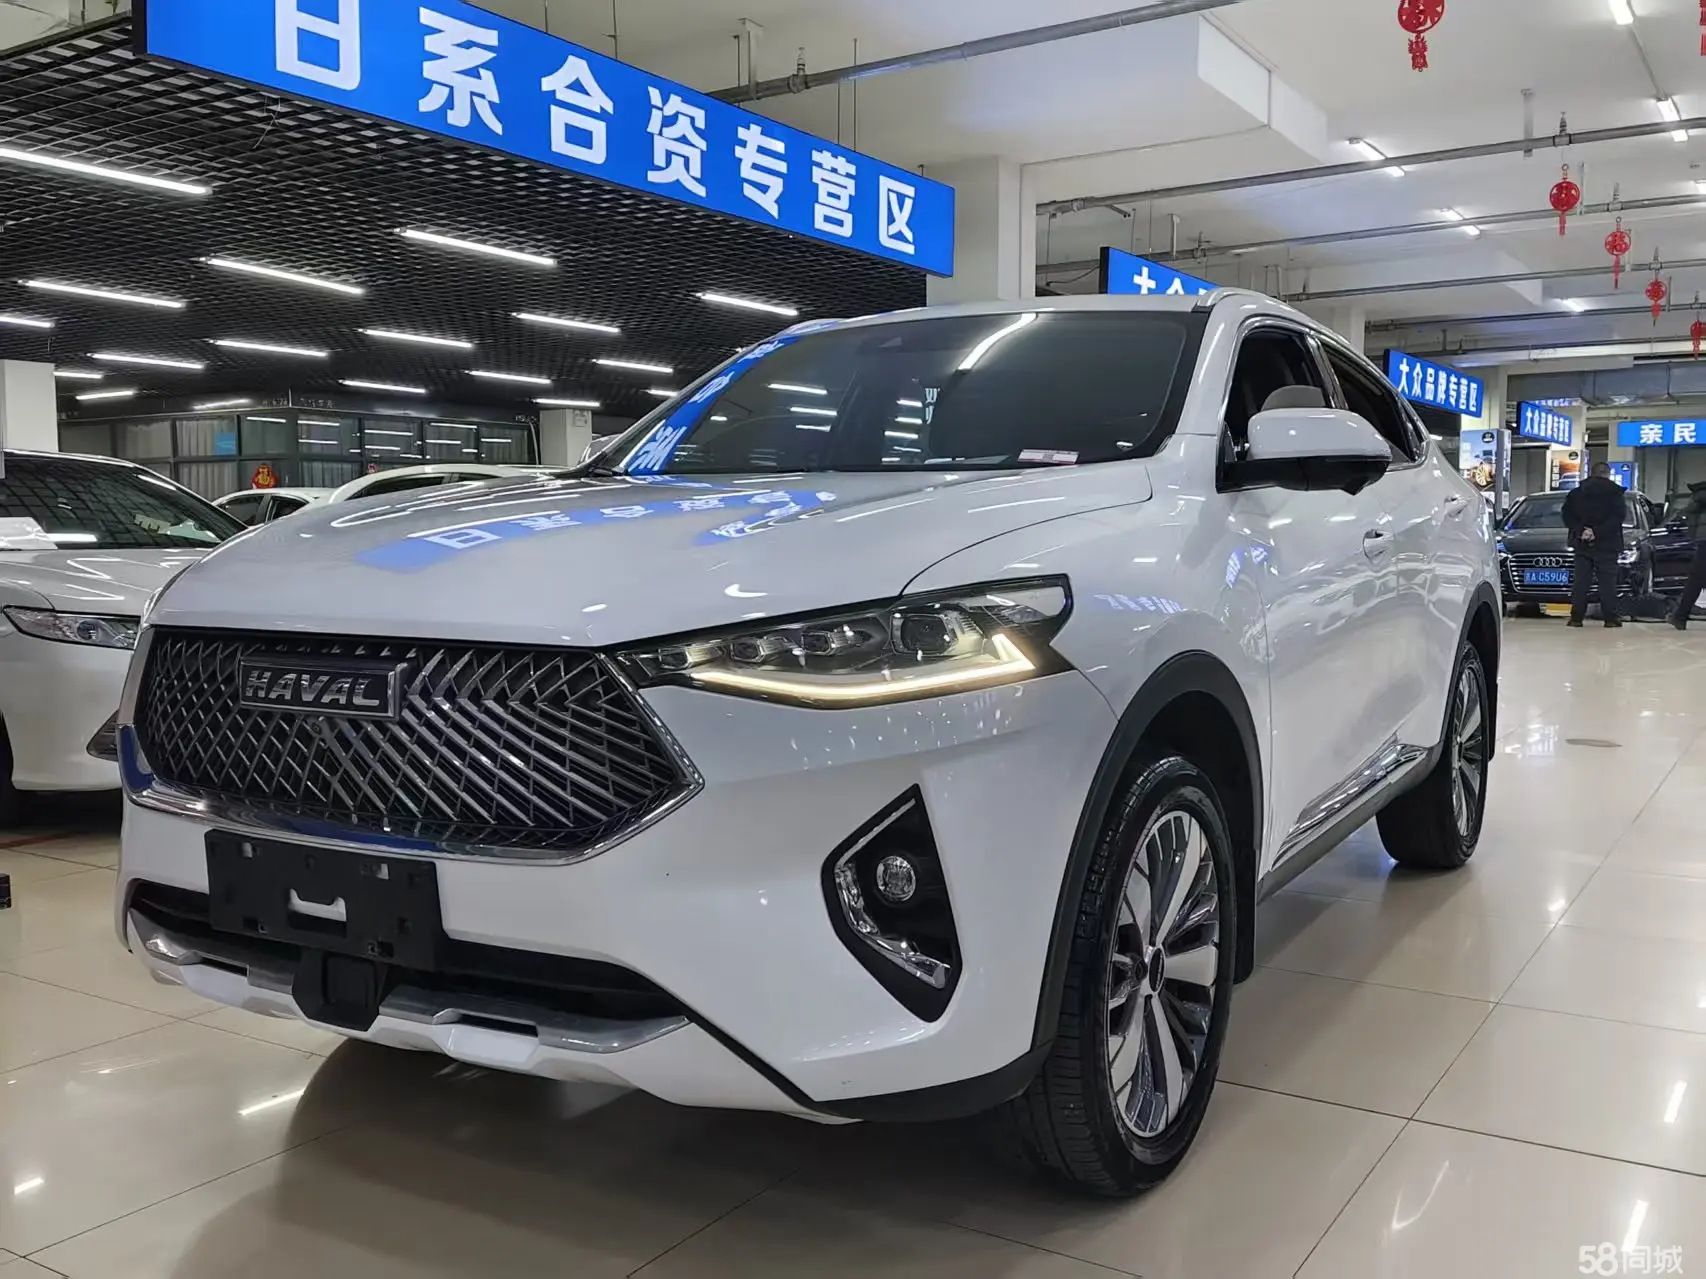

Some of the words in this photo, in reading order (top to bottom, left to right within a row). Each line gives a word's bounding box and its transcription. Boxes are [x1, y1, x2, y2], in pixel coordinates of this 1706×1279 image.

[275, 0, 917, 255] 日系合资专营区
[1398, 357, 1478, 411] 大众品牌专营区
[1640, 423, 1697, 444] 亲民
[245, 670, 380, 706] HAVAL
